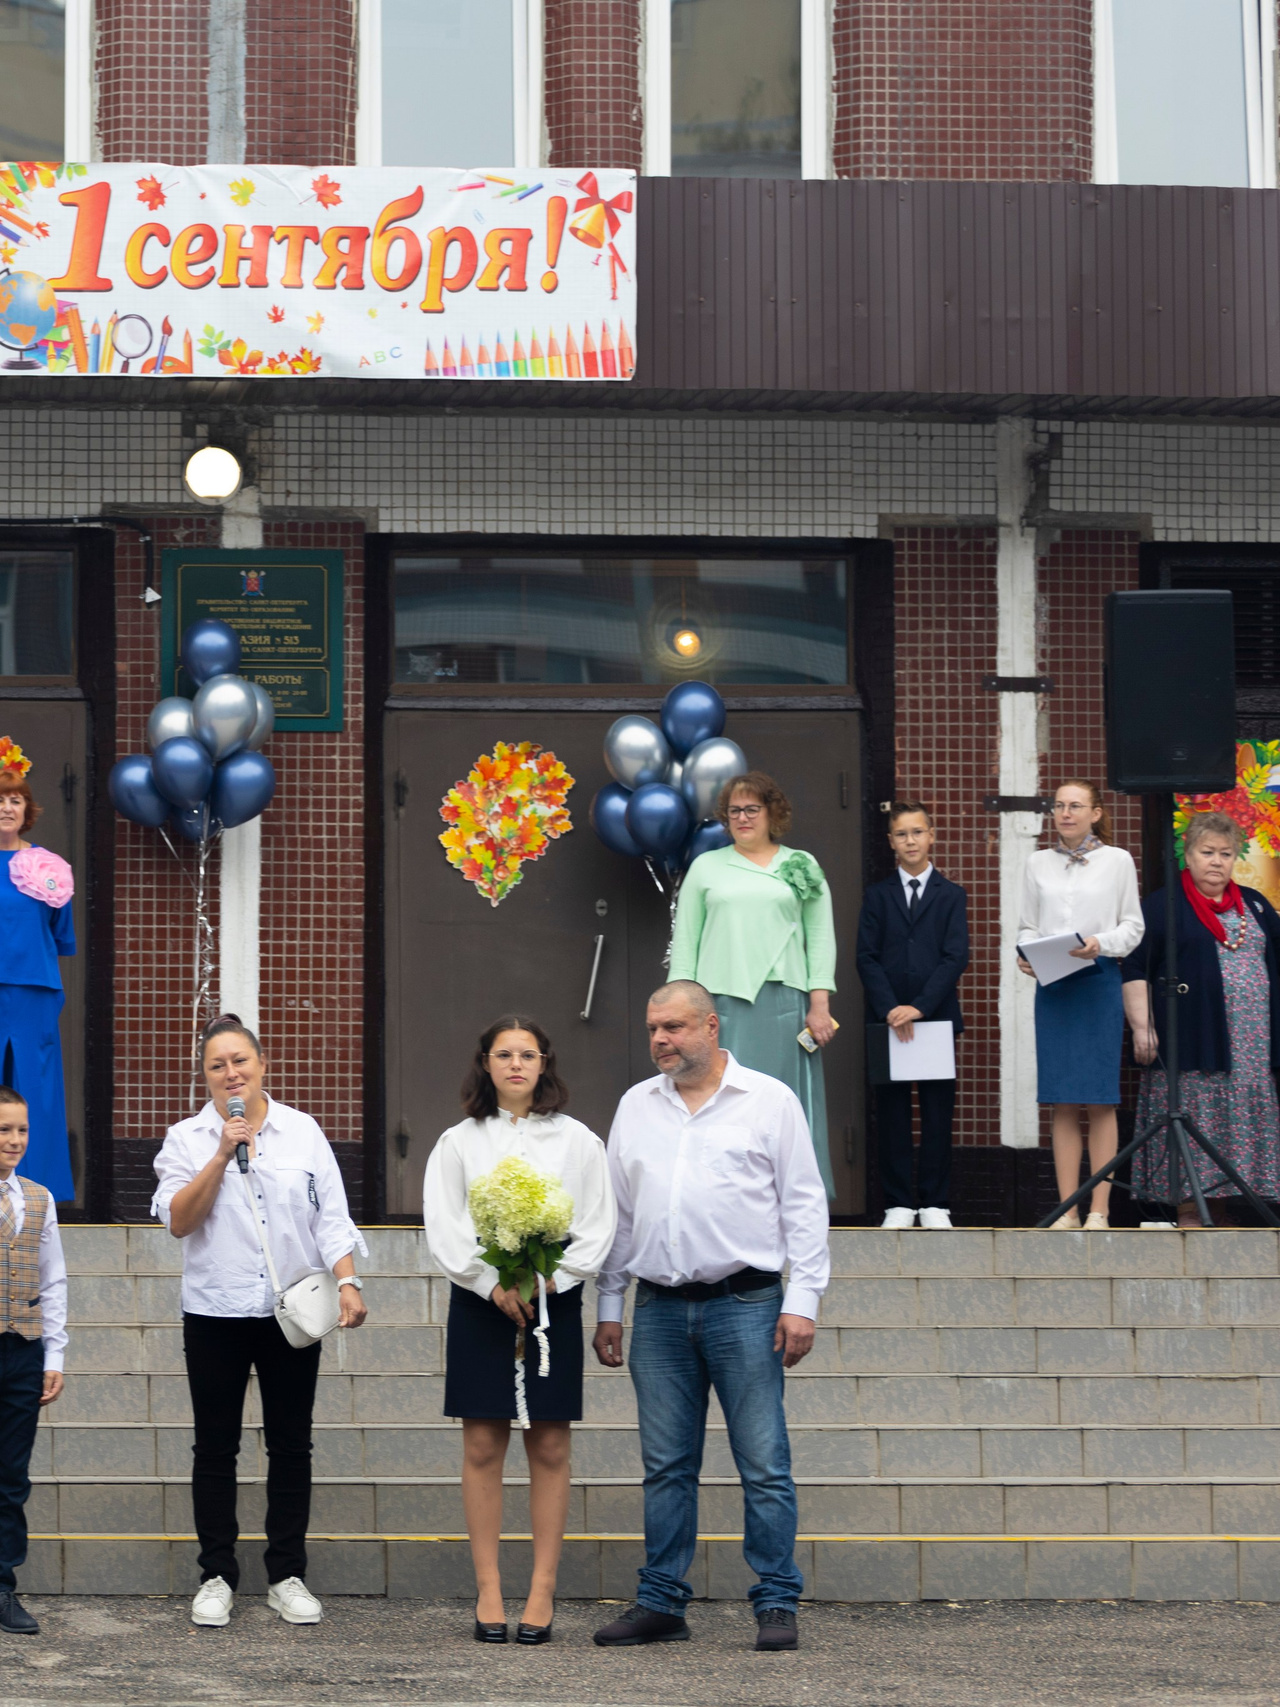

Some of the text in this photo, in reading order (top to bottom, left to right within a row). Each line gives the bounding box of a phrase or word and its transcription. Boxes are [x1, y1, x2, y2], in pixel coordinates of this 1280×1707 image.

[49, 181, 568, 313] 1 сентября!
[240, 635, 271, 645] АЗИЯ
